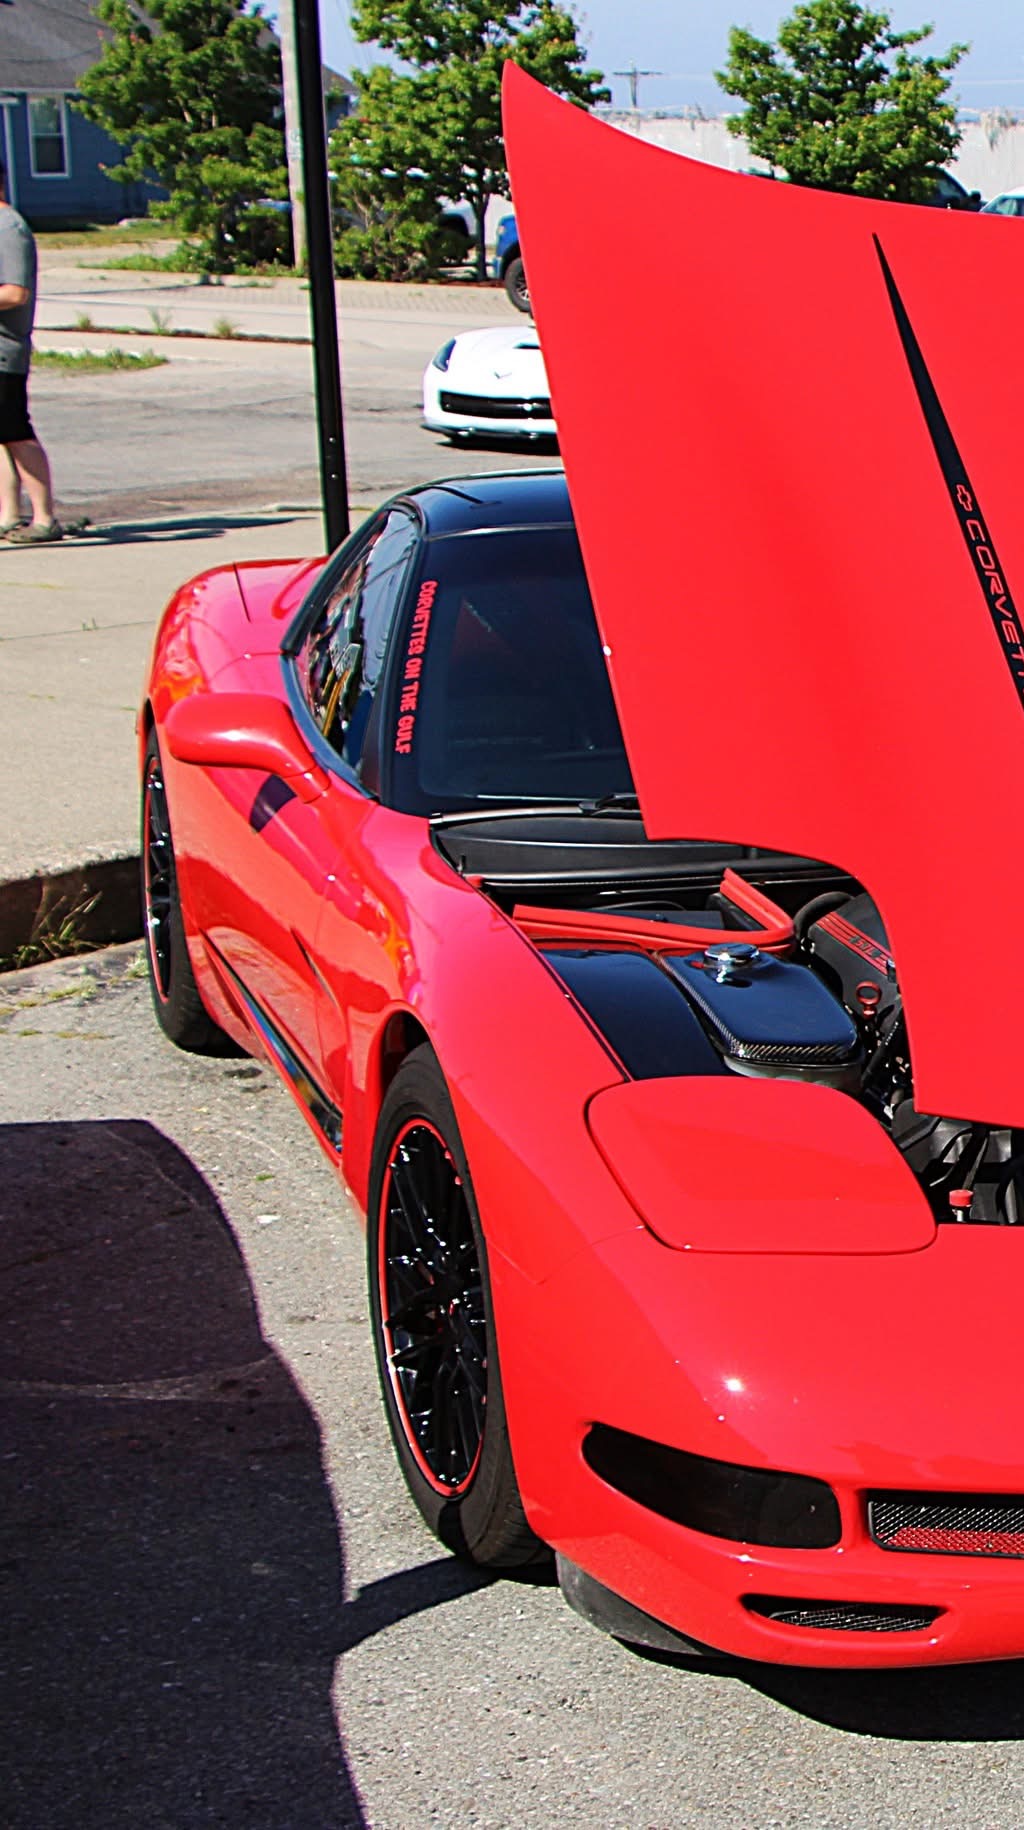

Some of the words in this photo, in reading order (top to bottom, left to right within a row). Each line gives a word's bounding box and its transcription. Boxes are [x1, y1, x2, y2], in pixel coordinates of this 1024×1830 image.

[408, 580, 438, 655] CORVETTES
[404, 657, 423, 679] ON
[400, 681, 419, 711] THE
[395, 715, 415, 753] GULF
